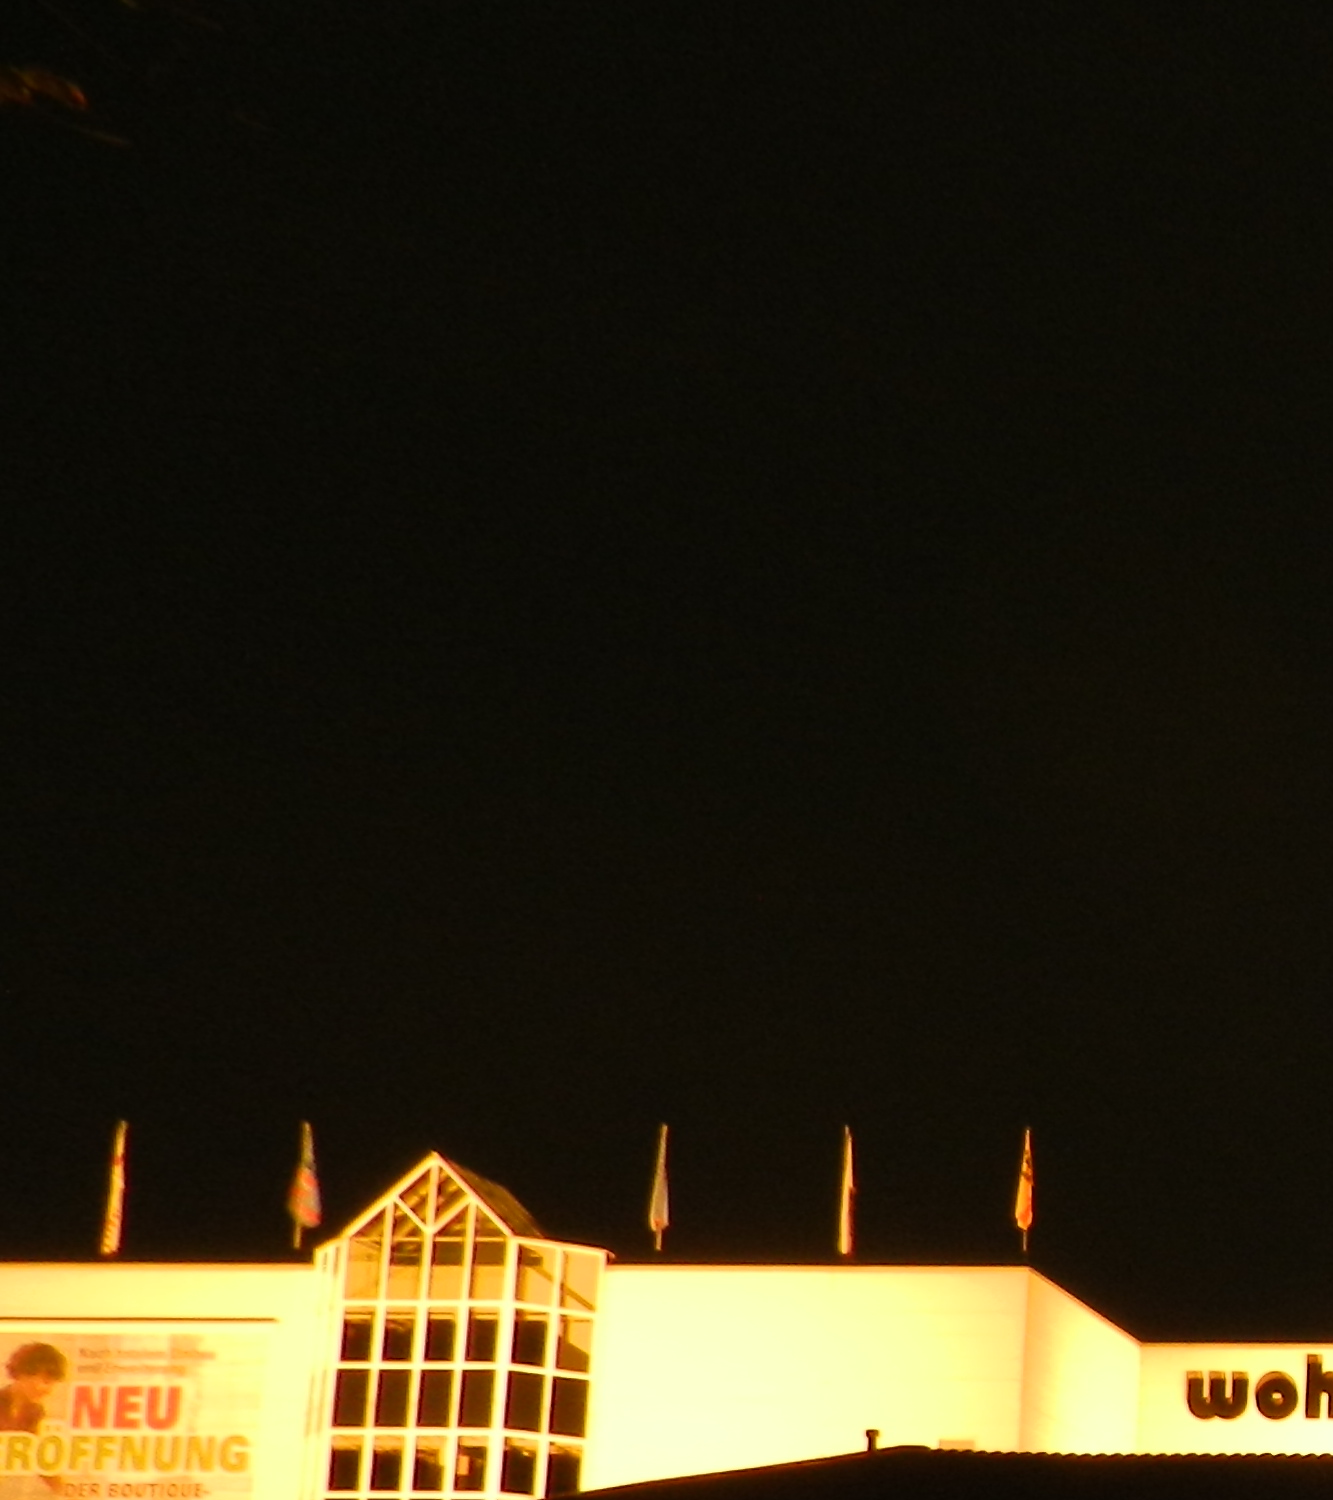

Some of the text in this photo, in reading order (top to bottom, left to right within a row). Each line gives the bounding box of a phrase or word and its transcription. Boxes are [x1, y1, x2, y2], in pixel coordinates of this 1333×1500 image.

[73, 1386, 182, 1429] NEU
[0, 1425, 249, 1472] RÖFFNUNG
[64, 1482, 212, 1499] DER BOUTIQUE-
